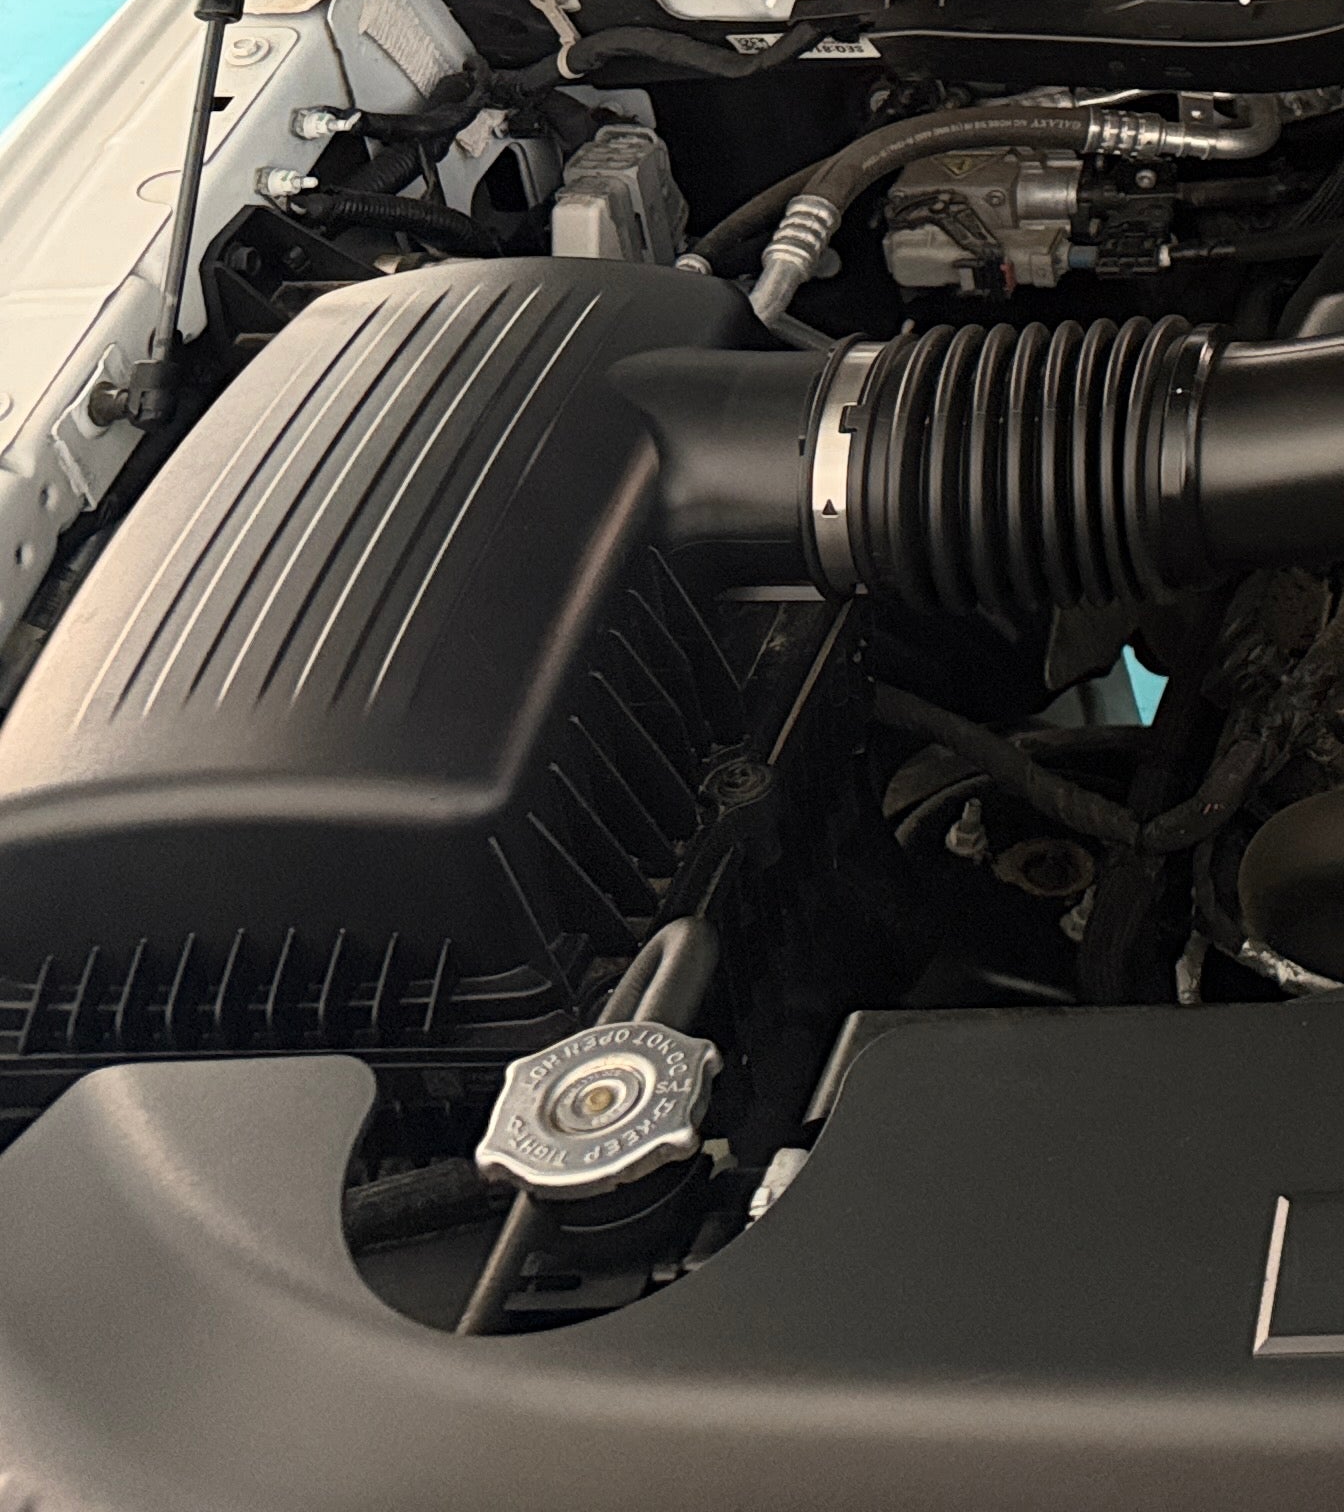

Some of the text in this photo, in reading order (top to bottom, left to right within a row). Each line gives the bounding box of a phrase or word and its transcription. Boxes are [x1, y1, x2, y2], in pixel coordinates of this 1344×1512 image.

[563, 1029, 630, 1059] OPEN
[632, 1030, 674, 1056] NOT
[583, 1121, 657, 1164] KEEP
